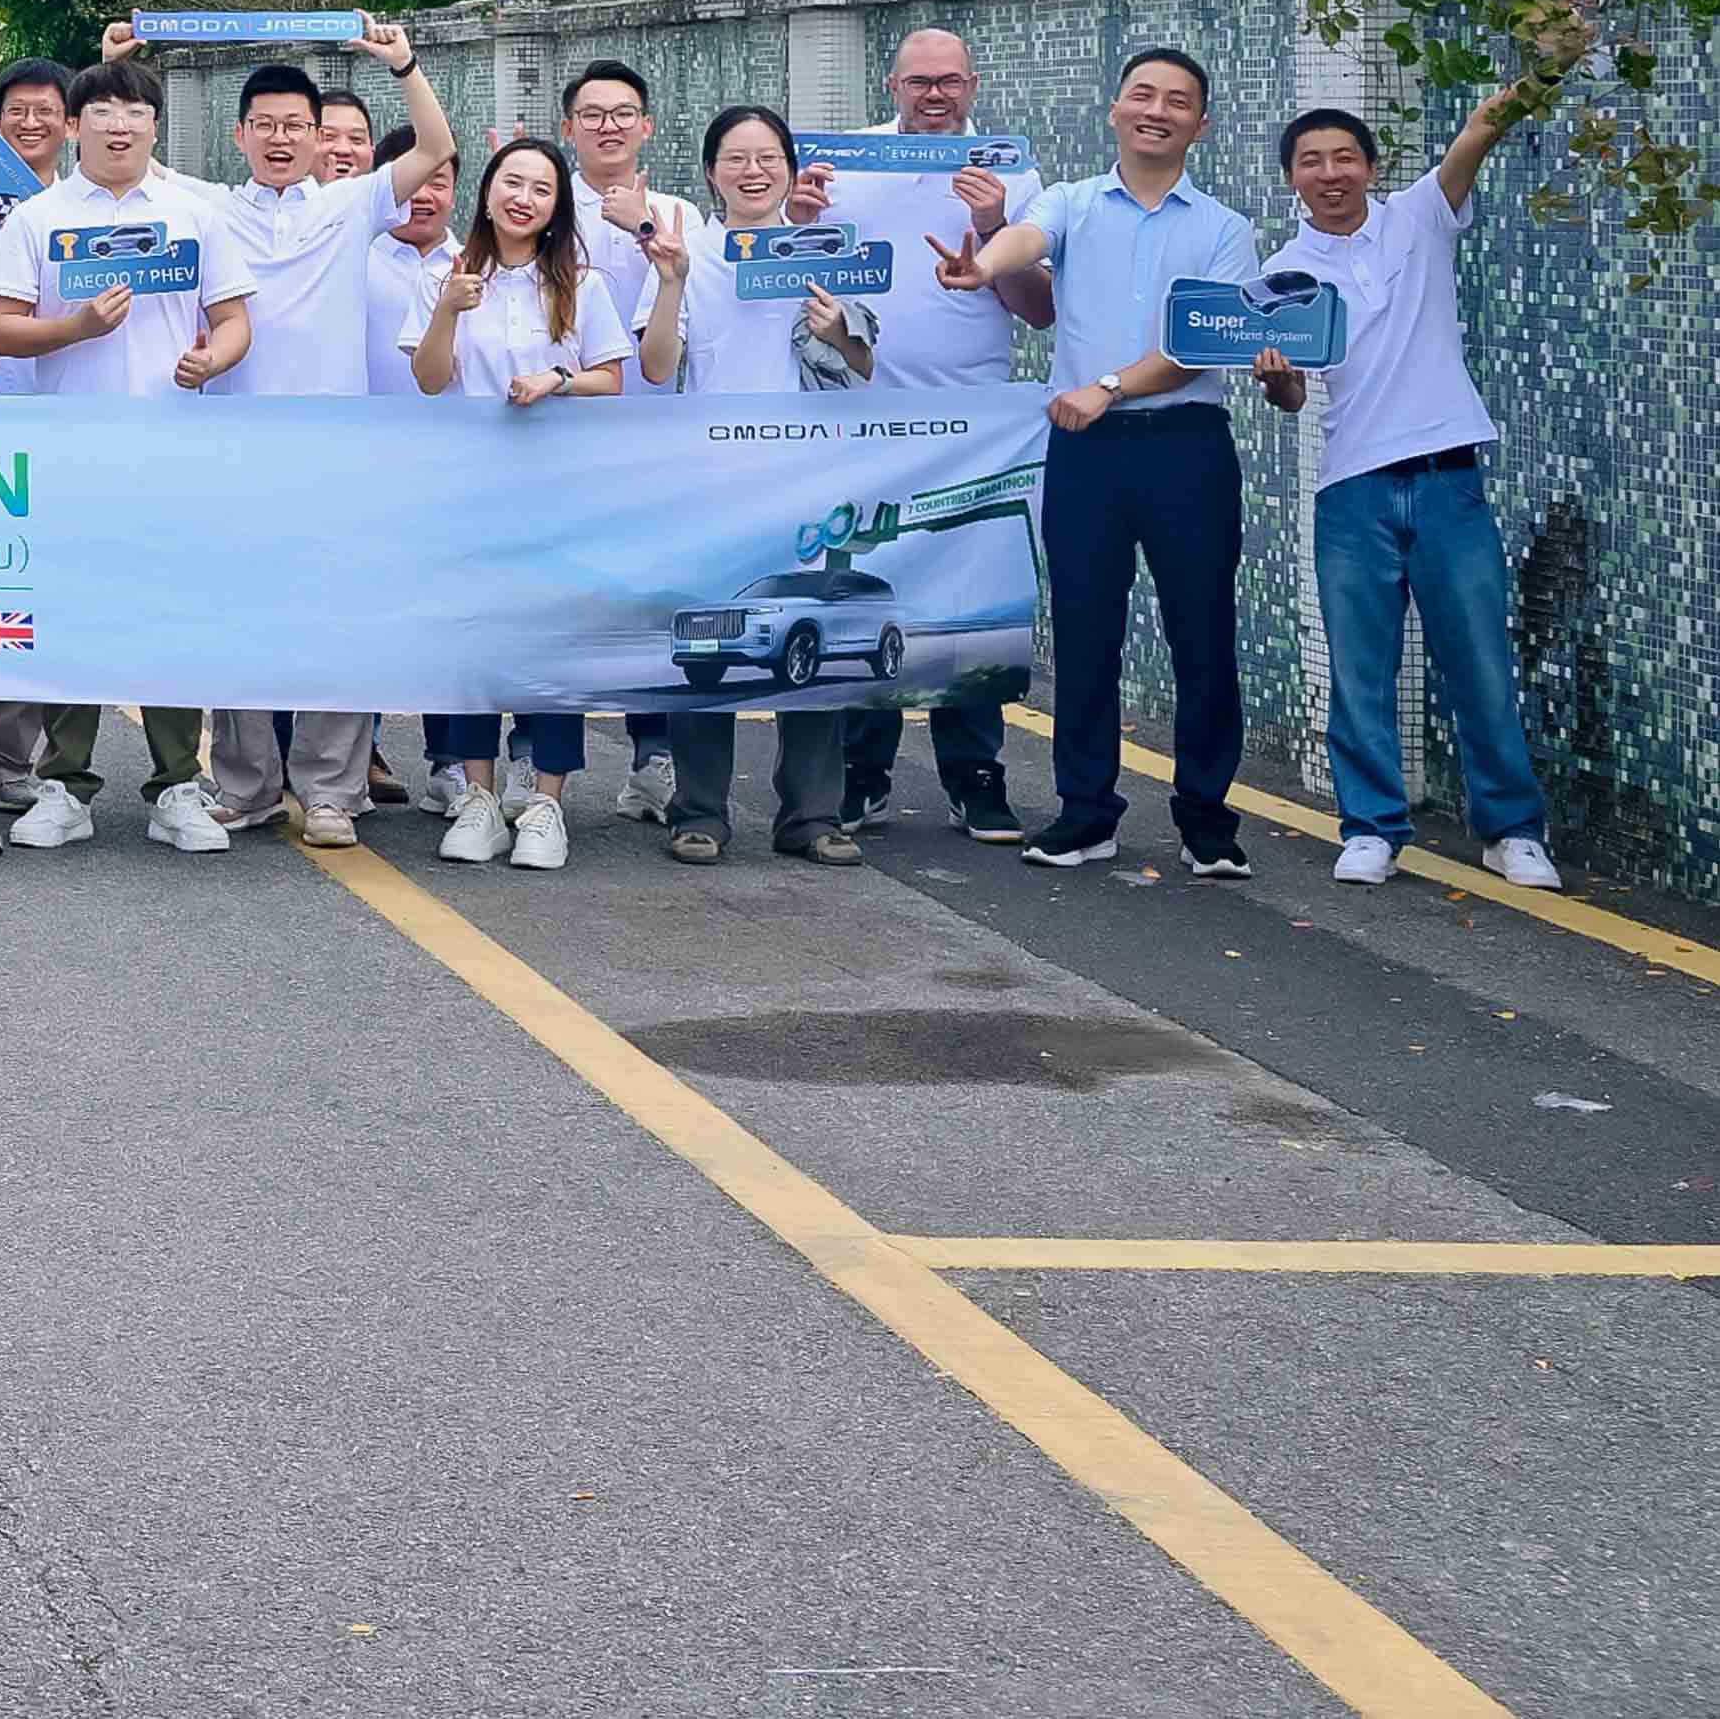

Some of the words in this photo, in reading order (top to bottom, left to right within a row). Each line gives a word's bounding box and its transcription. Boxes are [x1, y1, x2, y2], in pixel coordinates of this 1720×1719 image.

[139, 18, 241, 33] OMODA
[256, 18, 358, 33] JAECOO
[64, 270, 131, 290] JAECOO
[136, 269, 146, 284] 7
[149, 265, 196, 284] PHEV
[744, 272, 815, 291] JAECOO
[819, 271, 832, 286] 7
[836, 267, 888, 286] PHEV
[1187, 310, 1248, 331] Super
[1222, 328, 1262, 344] Hybrid
[1264, 329, 1313, 344] System
[708, 422, 830, 441] OMODA
[849, 419, 969, 438] JAECOO
